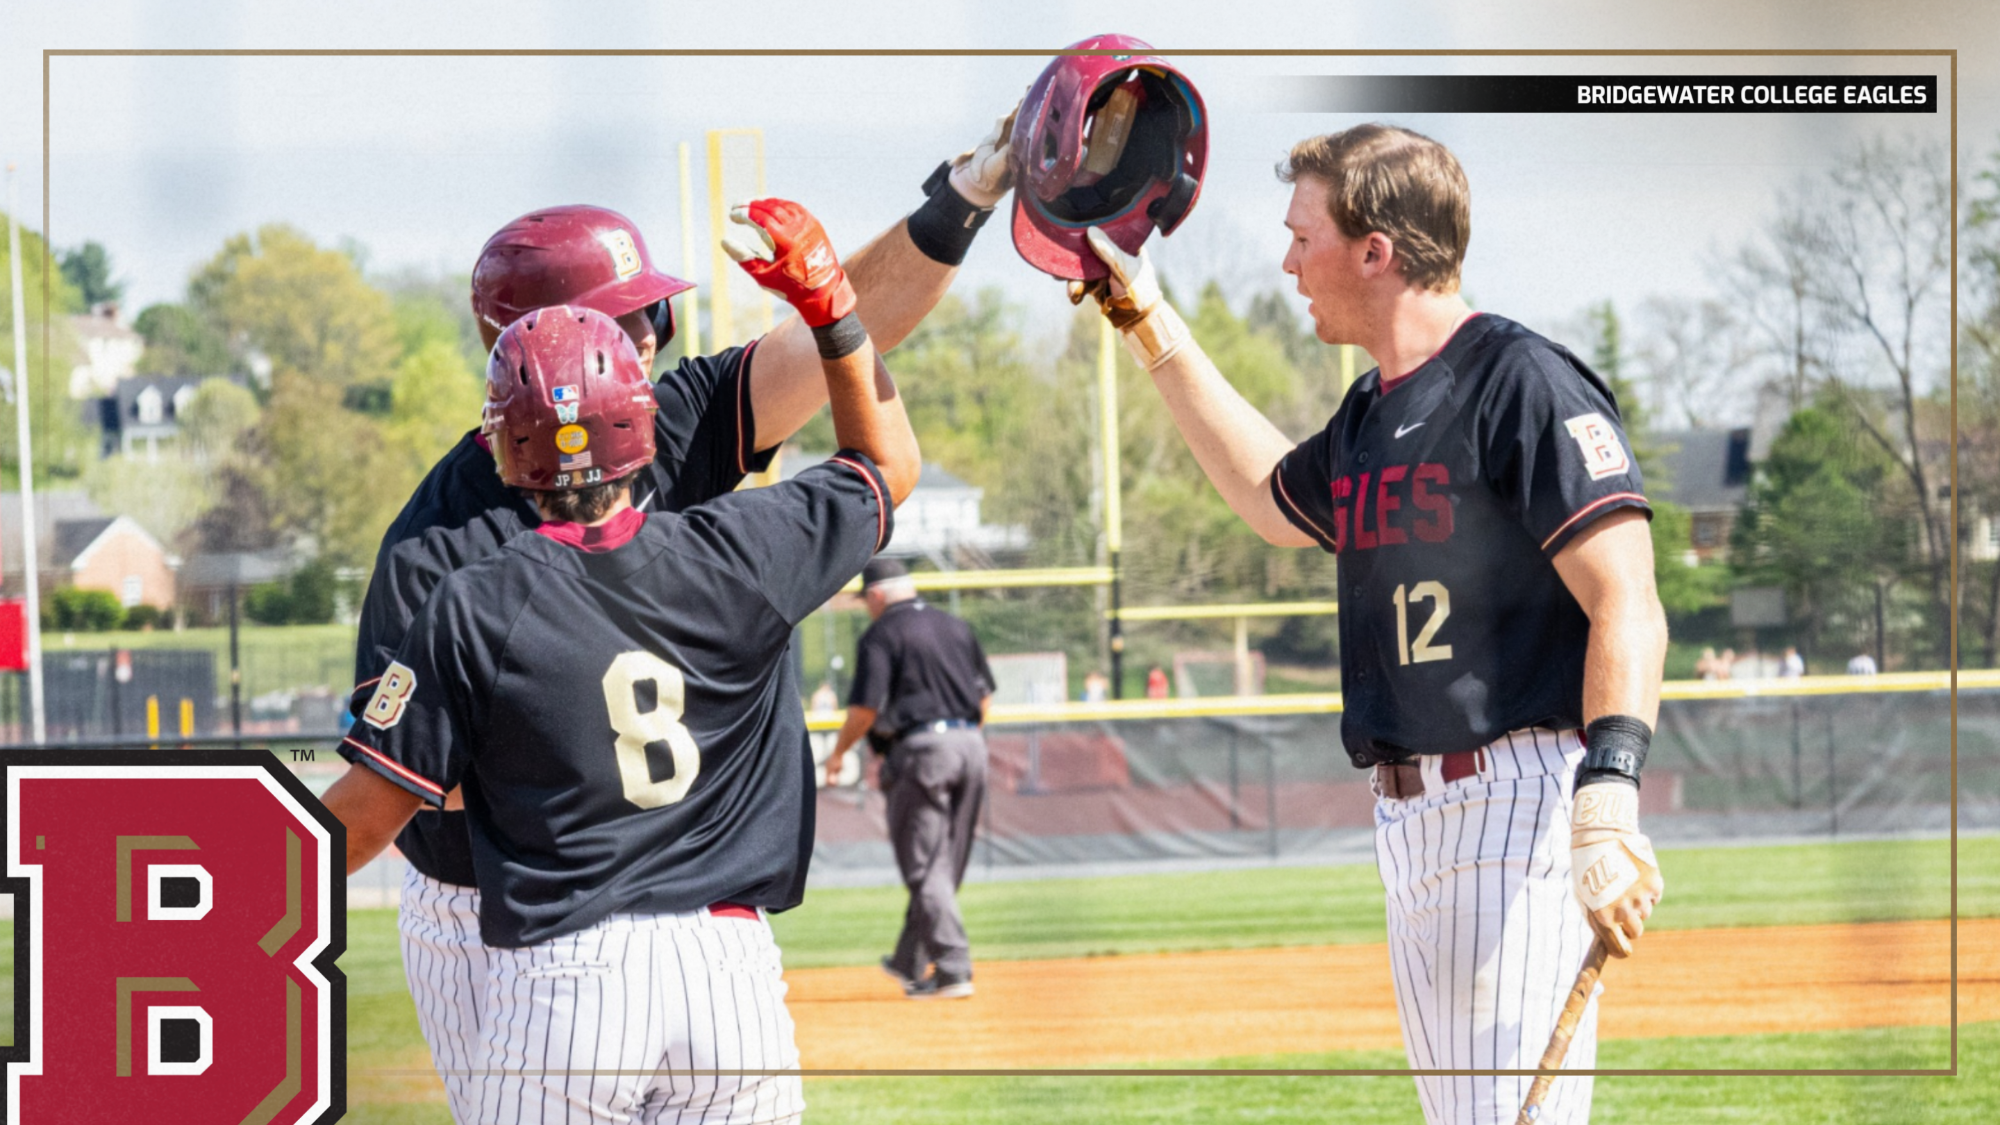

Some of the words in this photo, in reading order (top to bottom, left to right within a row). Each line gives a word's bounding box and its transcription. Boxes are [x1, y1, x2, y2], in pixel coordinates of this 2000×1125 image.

[603, 228, 642, 281] B
[555, 472, 570, 487] JP
[586, 468, 602, 483] JJ
[1564, 412, 1631, 481] B
[1392, 580, 1453, 666] 12
[362, 660, 418, 731] B
[602, 650, 701, 810] 8
